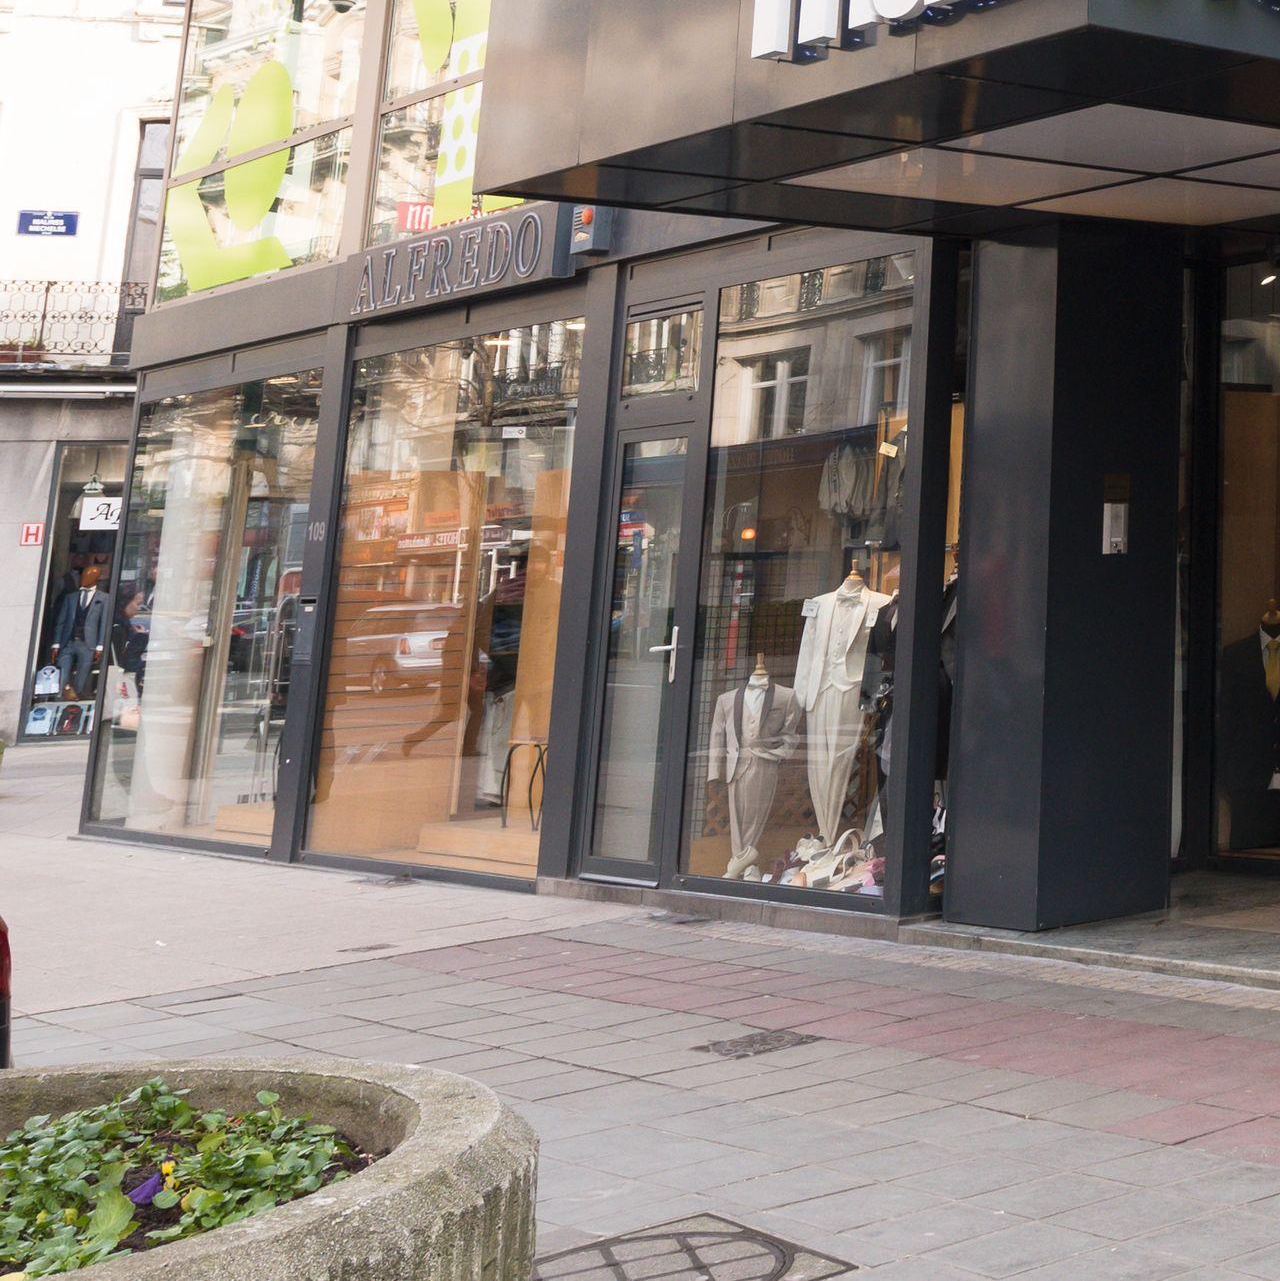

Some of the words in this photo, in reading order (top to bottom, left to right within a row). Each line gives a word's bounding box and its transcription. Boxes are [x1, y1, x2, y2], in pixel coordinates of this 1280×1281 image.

[350, 212, 542, 315] ALFREDO
[24, 525, 40, 543] H
[308, 521, 326, 542] 109
